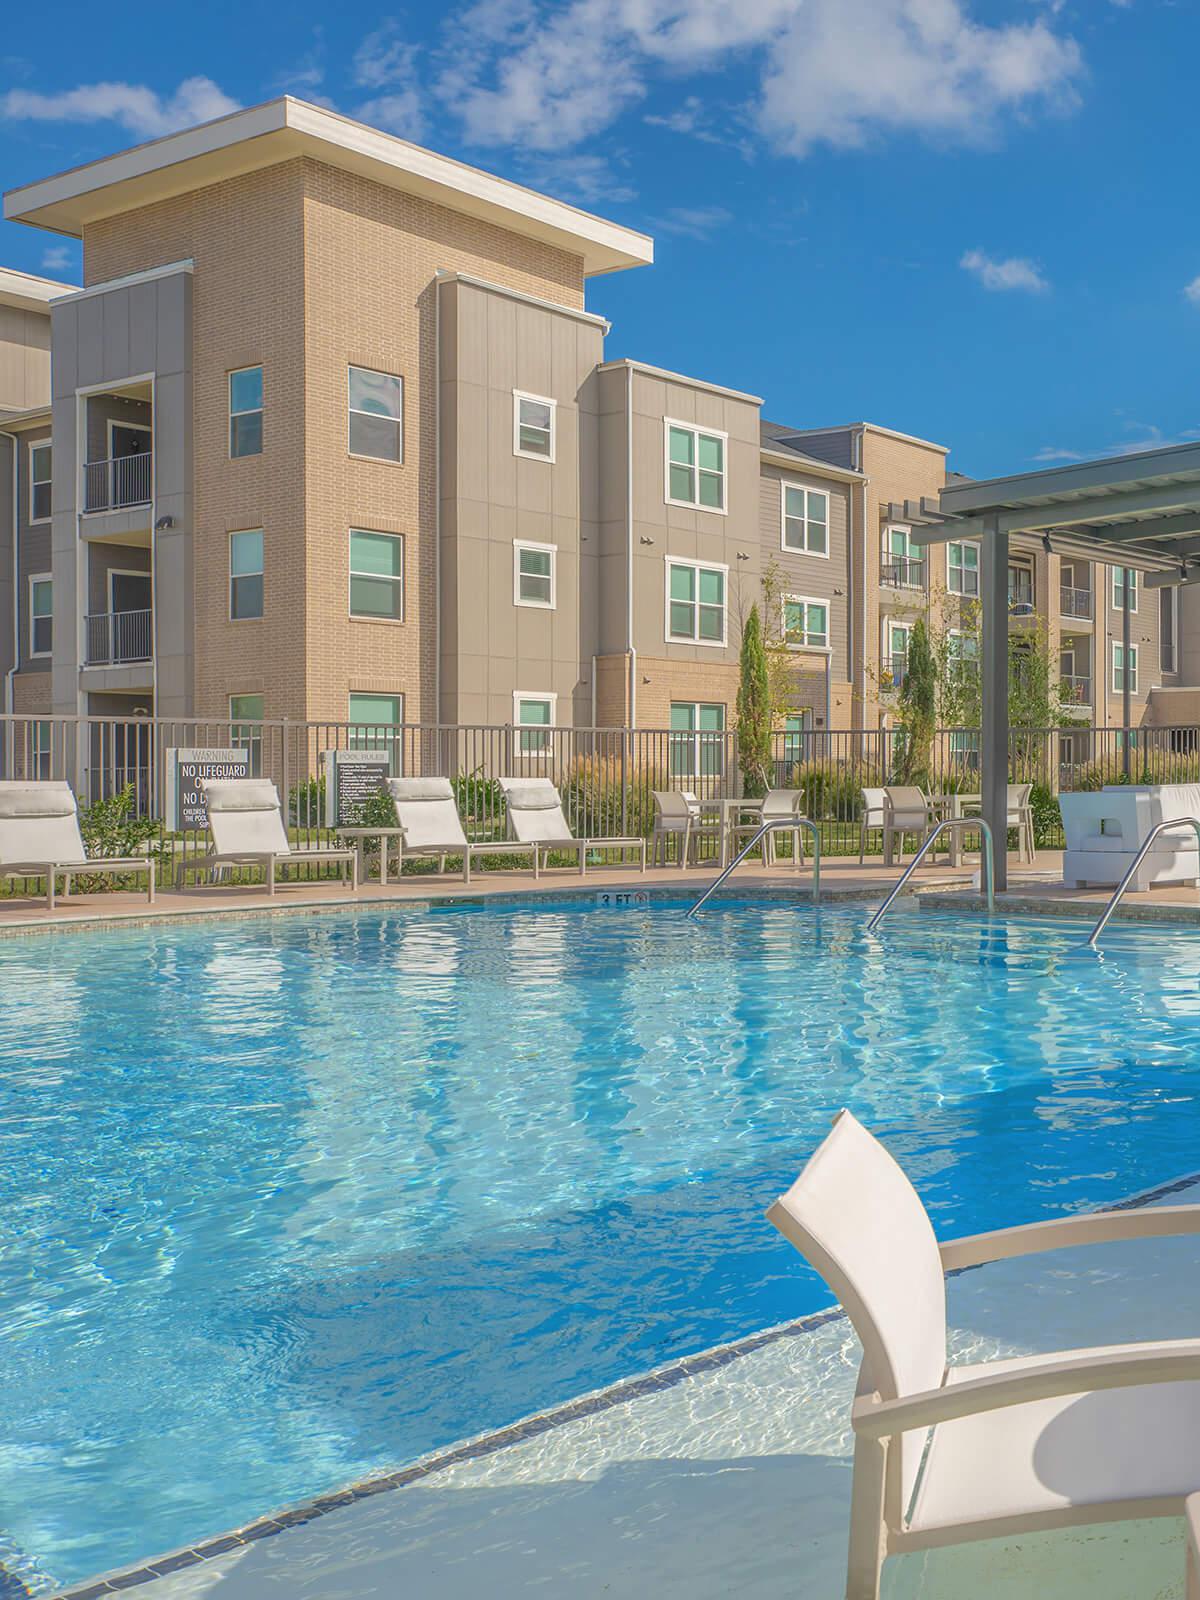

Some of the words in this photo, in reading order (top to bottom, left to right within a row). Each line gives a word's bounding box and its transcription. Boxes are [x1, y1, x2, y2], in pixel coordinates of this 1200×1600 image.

[192, 750, 234, 761] WARNING
[182, 765, 195, 777] NO
[199, 765, 246, 777] LIFEGUARD
[183, 792, 197, 804] NO
[615, 894, 631, 905] FT
